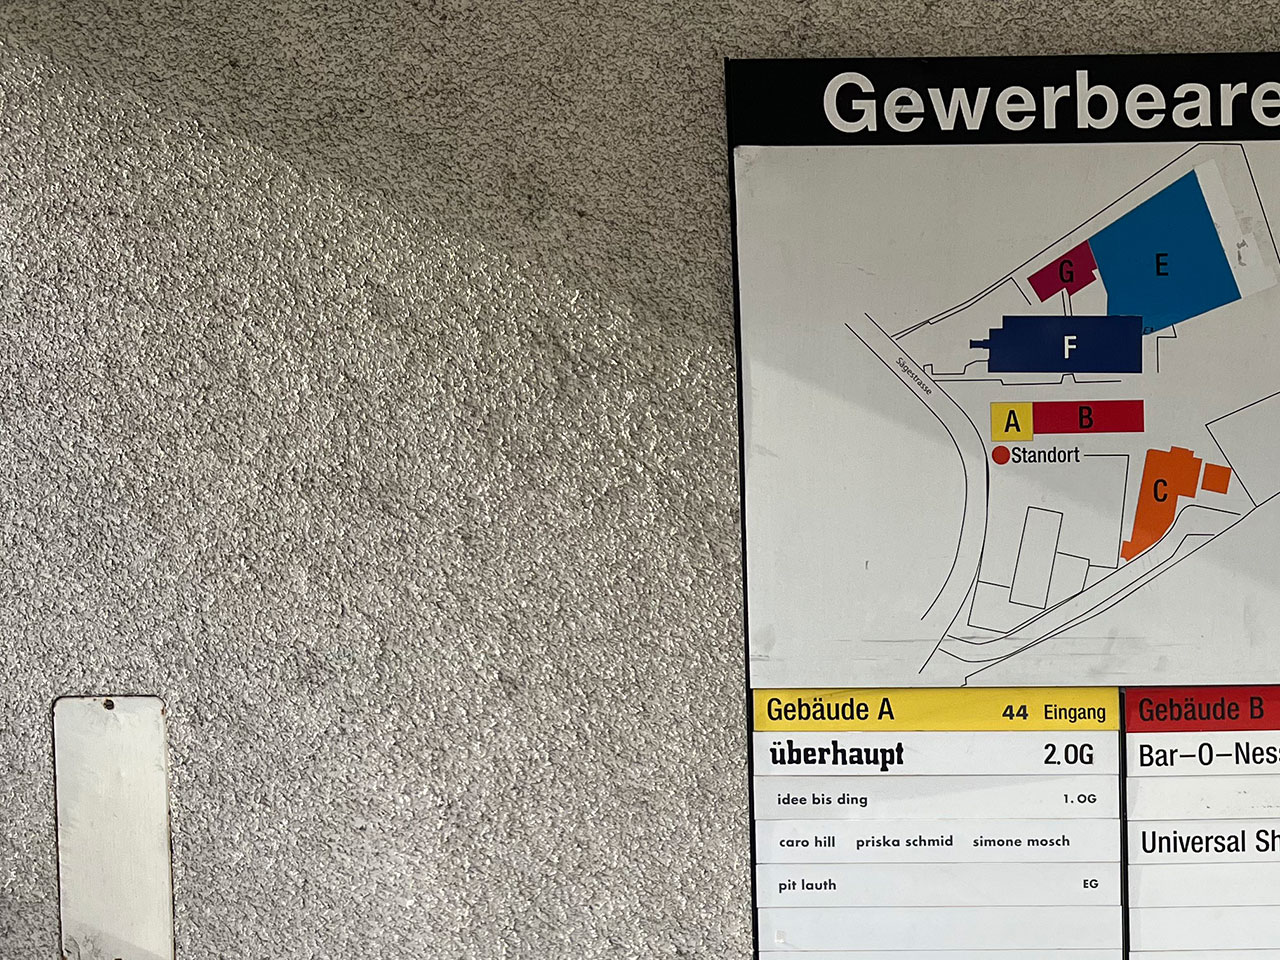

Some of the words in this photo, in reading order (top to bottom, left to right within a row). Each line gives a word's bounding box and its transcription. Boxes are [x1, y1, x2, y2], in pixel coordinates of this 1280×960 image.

[1059, 260, 1073, 283] G
[1156, 253, 1168, 276] E
[1065, 336, 1076, 358] F
[896, 357, 932, 395] Sägestrasse
[1005, 410, 1020, 432] A
[1079, 406, 1093, 428] B
[1012, 447, 1080, 463] Standort
[1154, 479, 1167, 502] C
[768, 698, 868, 720] Gebäude
[878, 698, 894, 720] A
[1002, 705, 1028, 720] 44
[1045, 705, 1105, 723] Eingang
[1139, 697, 1239, 721] Gebäude
[1250, 697, 1264, 719] B
[770, 740, 903, 771] überhaupt
[778, 794, 806, 804] idee
[812, 794, 831, 804] bis
[838, 793, 867, 807] ding
[815, 836, 835, 847] hill
[857, 836, 900, 850] priska
[906, 835, 953, 846] schmid
[973, 836, 1021, 846] simone
[1028, 835, 1069, 846] mosch
[1142, 830, 1245, 853] Universal
[779, 881, 796, 893] pit
[802, 879, 836, 890] lauth
[1084, 879, 1098, 888] EG
